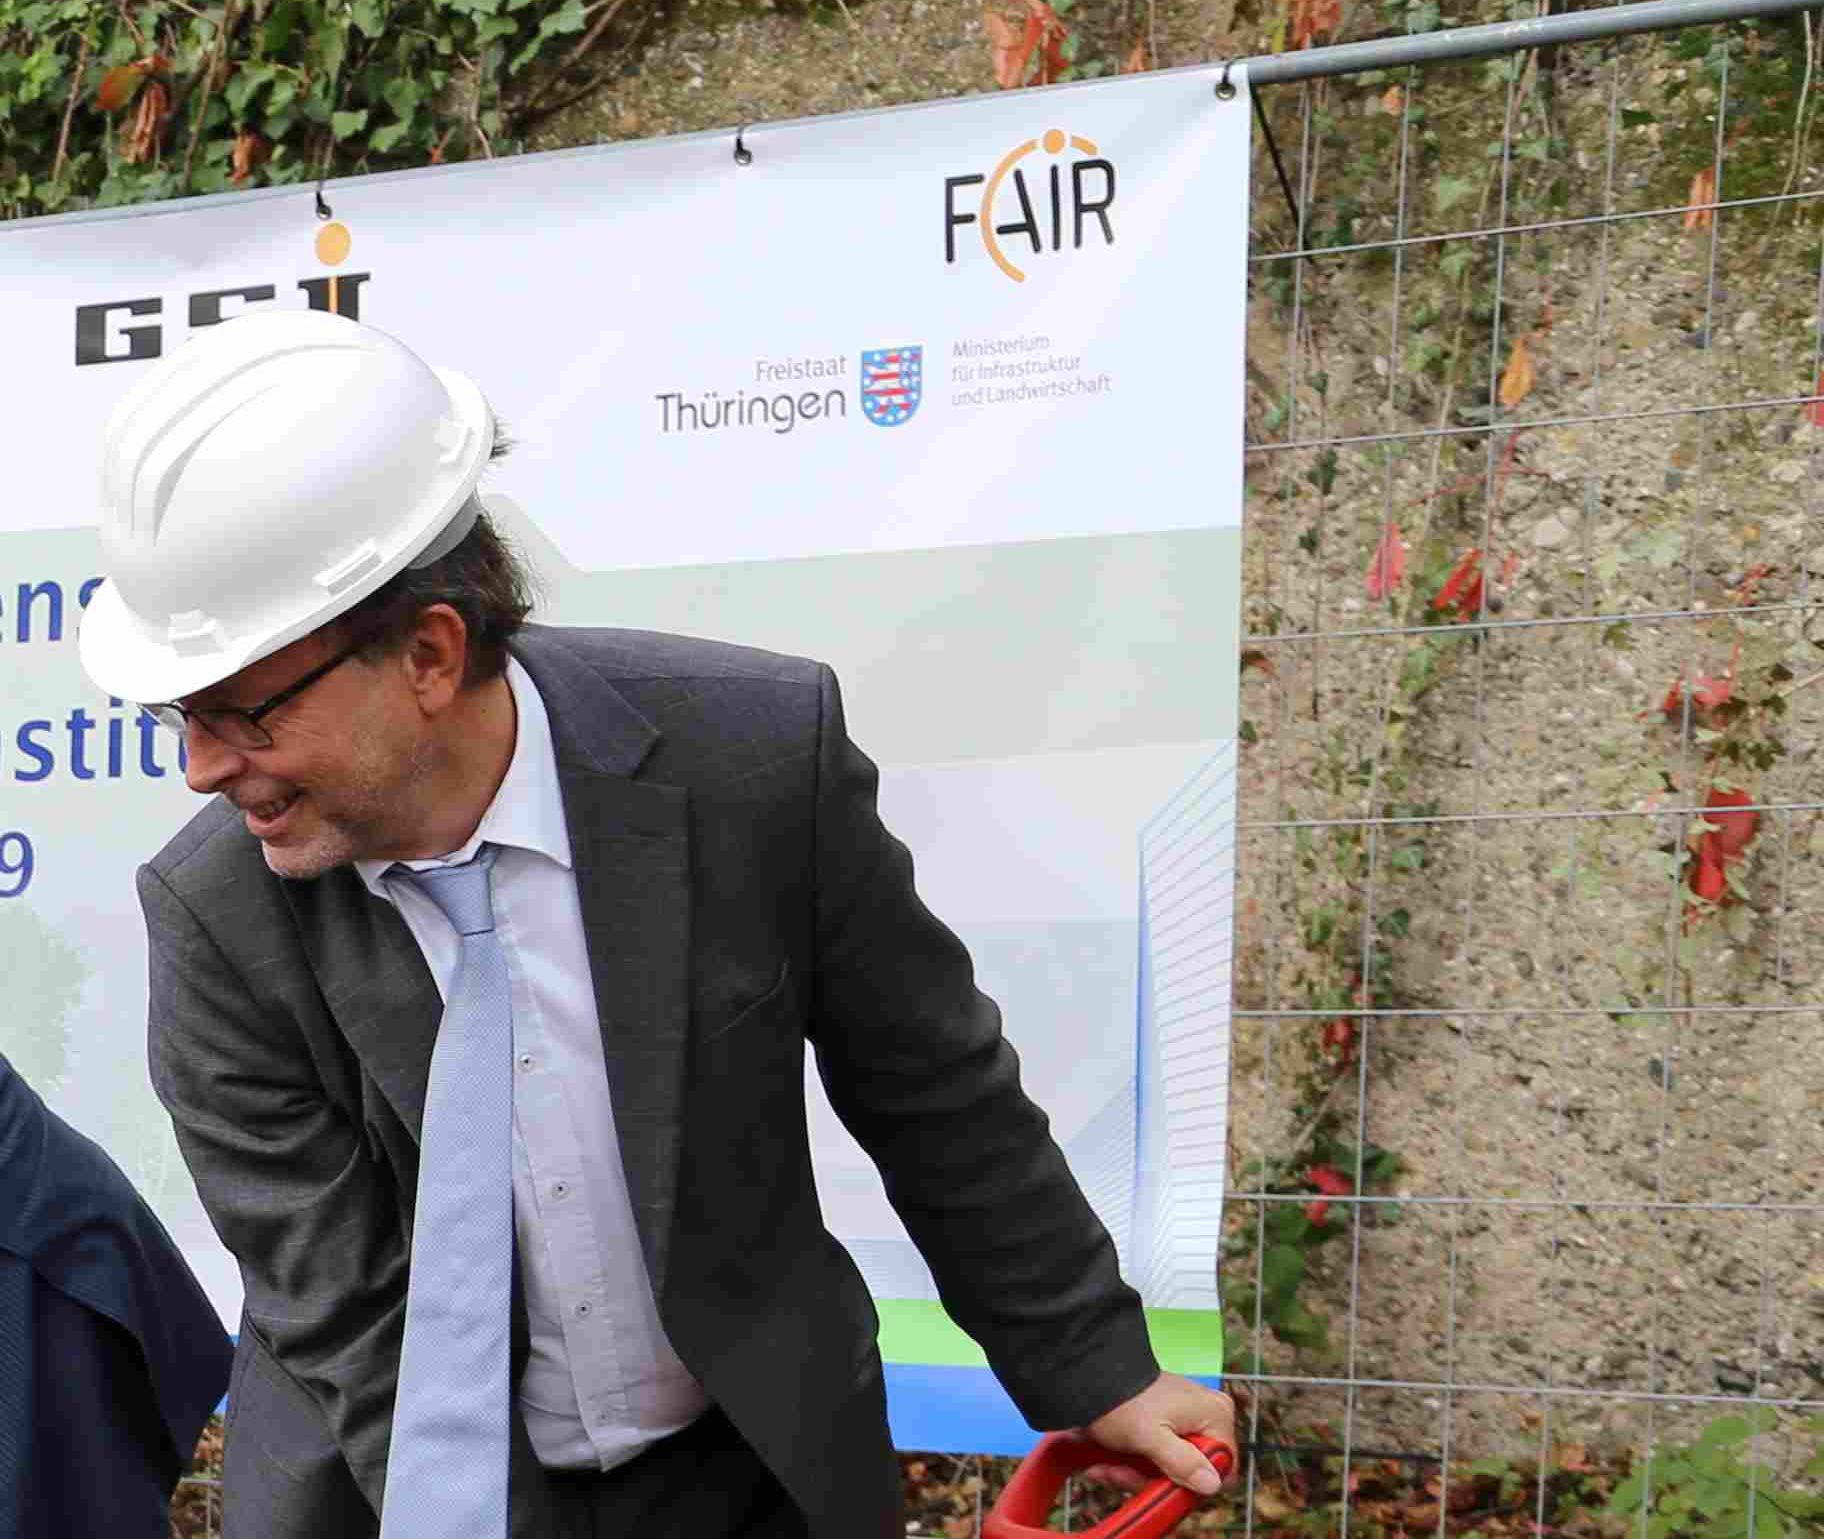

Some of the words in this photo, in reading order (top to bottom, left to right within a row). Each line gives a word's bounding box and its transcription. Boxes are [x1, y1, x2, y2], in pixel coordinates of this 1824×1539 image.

[945, 157, 1115, 264] FAIR
[952, 332, 1050, 358] Ministerium
[755, 354, 848, 382] Freistaat
[951, 363, 974, 382] für
[978, 354, 1081, 380] Infrastruktur
[951, 386, 984, 406] und
[987, 373, 1113, 403] Landwirtschaft
[655, 388, 848, 435] Thüringen
